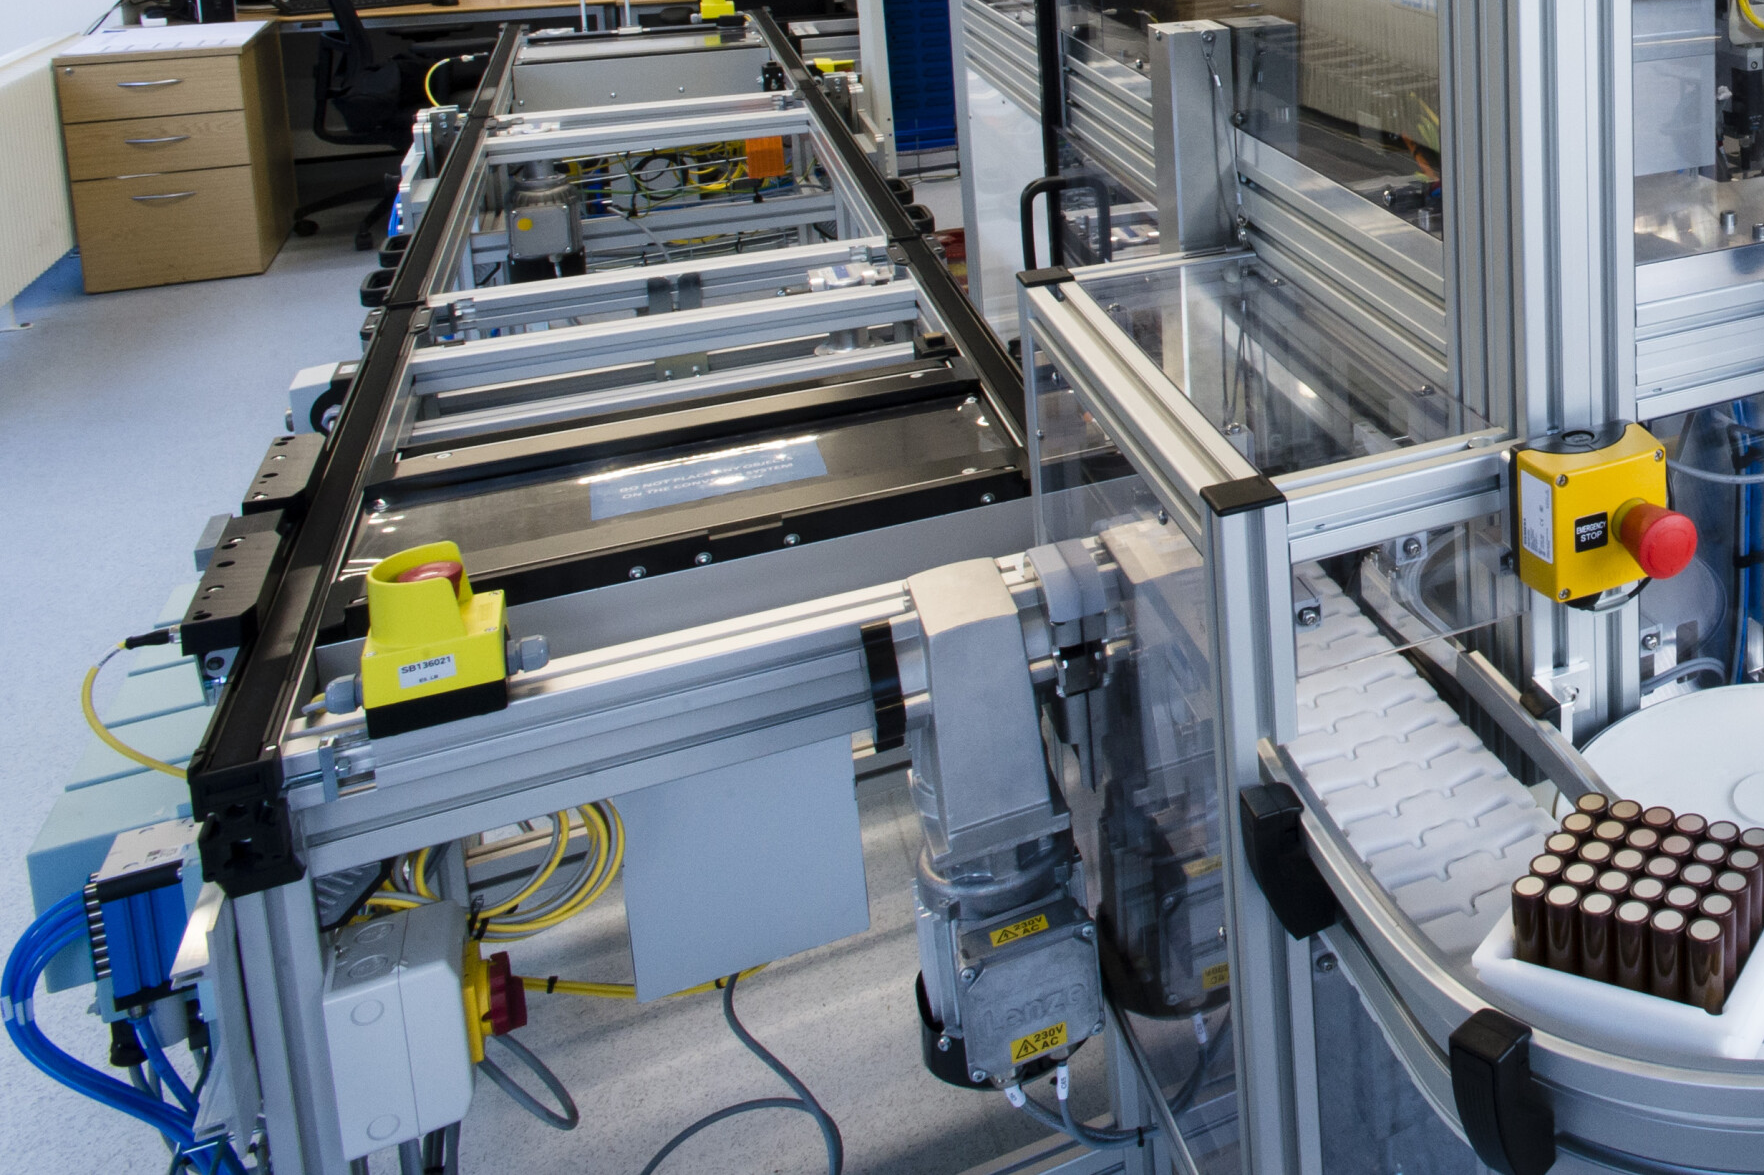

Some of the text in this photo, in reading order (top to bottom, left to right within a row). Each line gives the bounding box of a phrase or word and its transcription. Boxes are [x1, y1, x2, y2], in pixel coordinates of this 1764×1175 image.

[642, 478, 669, 489] NOT
[646, 486, 669, 495] THE
[747, 462, 793, 475] SYSTEM
[1576, 520, 1607, 535] EMERGENCY
[1580, 530, 1603, 543] STOP
[401, 655, 451, 674] SB136021
[1014, 916, 1042, 931] 230V
[1022, 924, 1039, 935] AC
[983, 982, 1085, 1031] Lenze
[1034, 1024, 1064, 1043] 230V
[1041, 1036, 1059, 1050] AC
